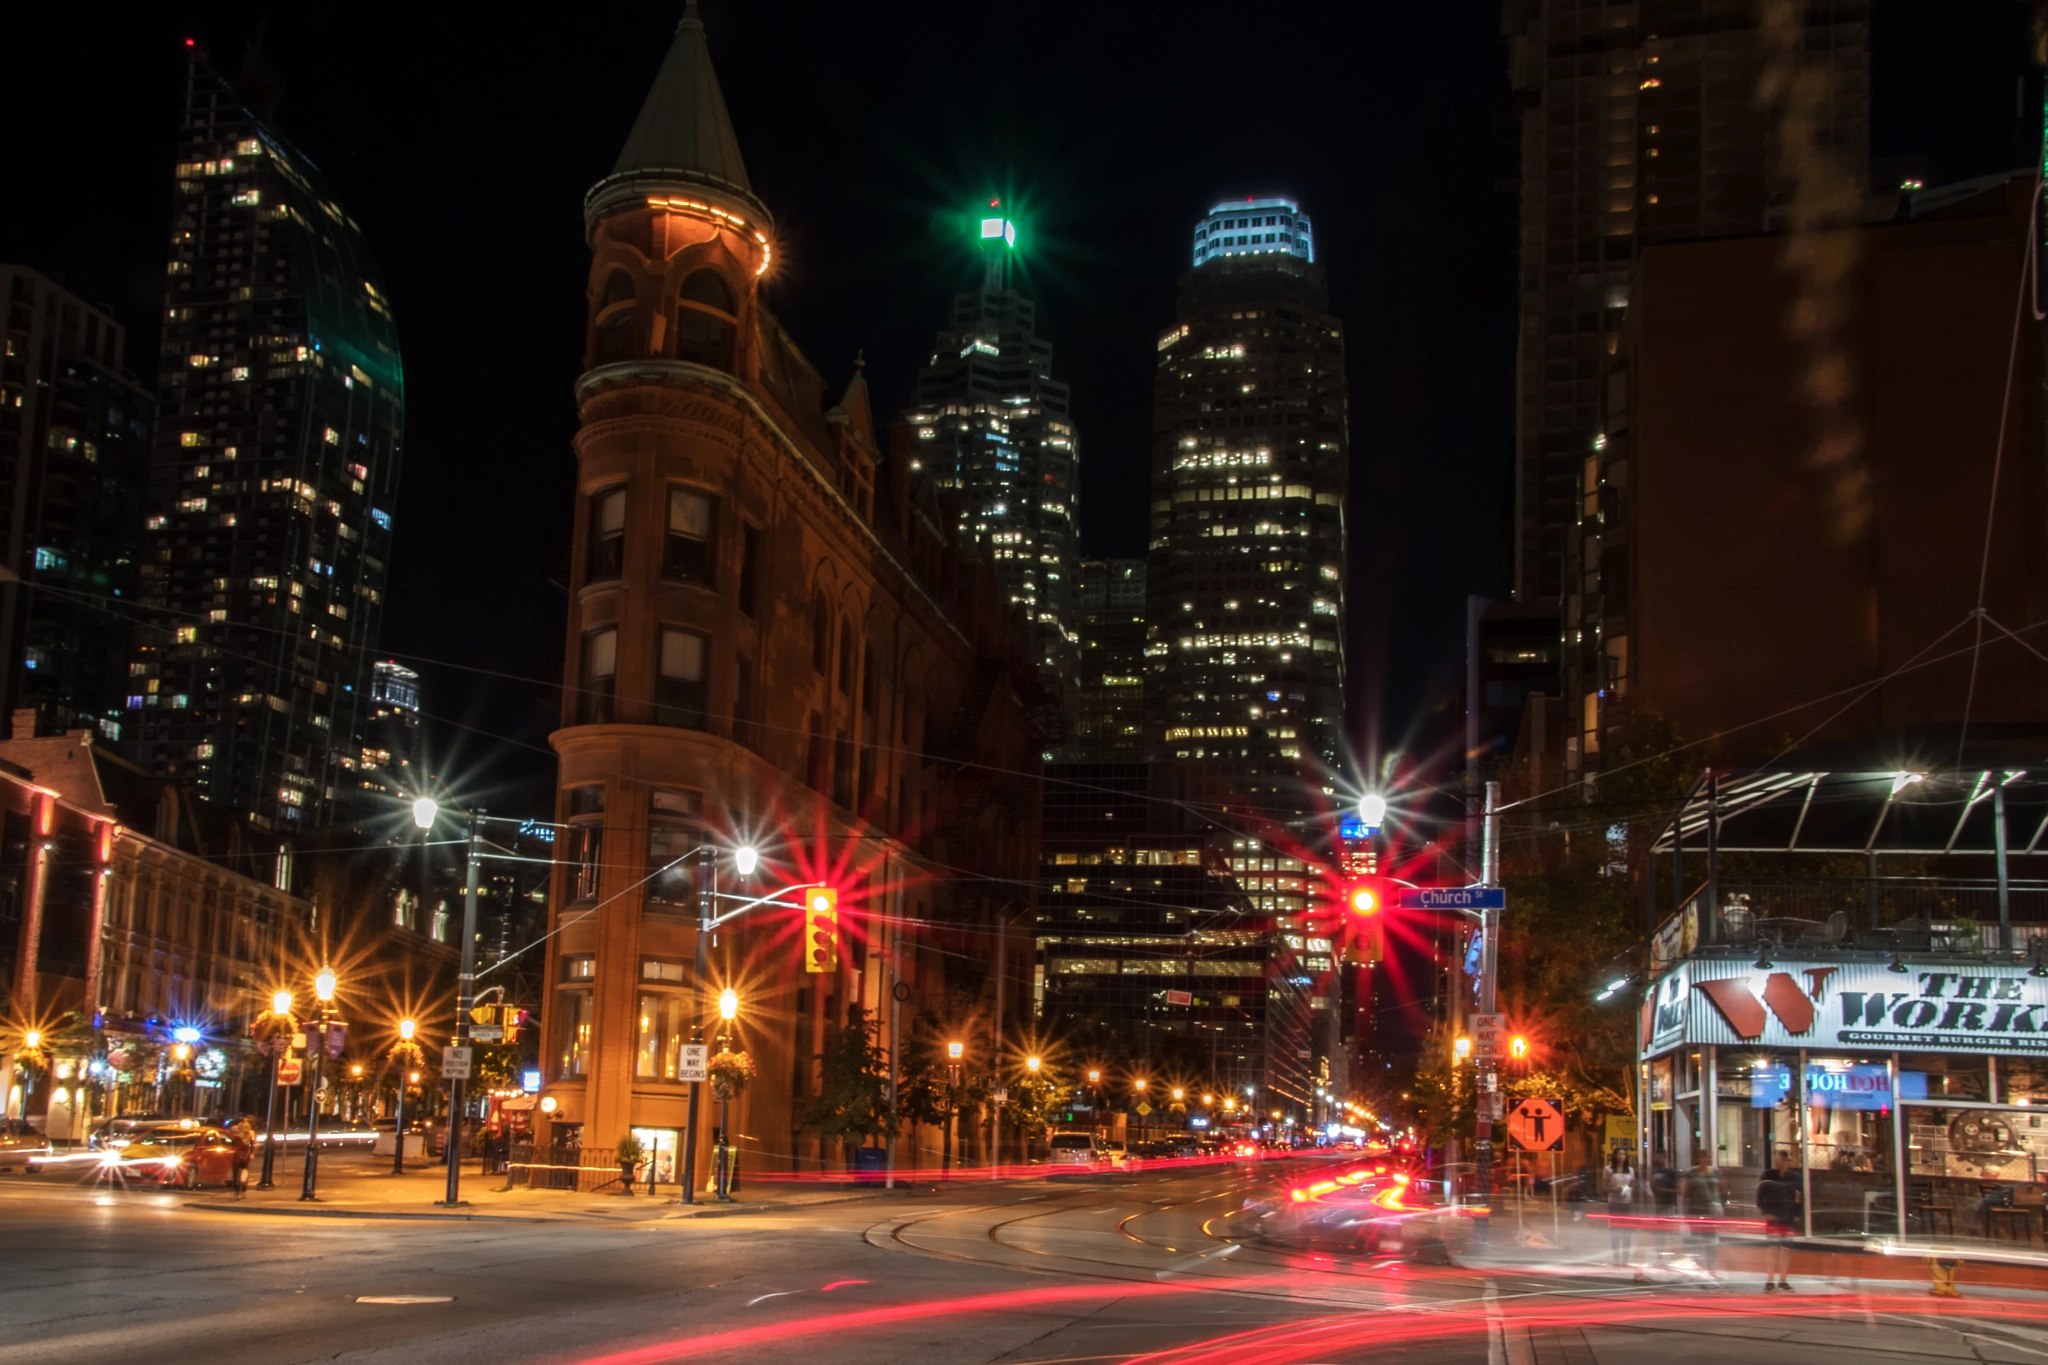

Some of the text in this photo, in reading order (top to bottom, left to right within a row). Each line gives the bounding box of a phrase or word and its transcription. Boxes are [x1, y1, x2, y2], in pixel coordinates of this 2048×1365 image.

[1420, 890, 1483, 904] Church St
[1918, 973, 2027, 1000] THE
[1837, 992, 2048, 1033] WORK
[1477, 1017, 1496, 1027] ONE
[1477, 1031, 1496, 1041] WAY
[1849, 1032, 1934, 1043] GOURMET
[1939, 1036, 2011, 1046] BURGER
[452, 1050, 463, 1059] NO
[687, 1048, 701, 1056] ONE
[687, 1059, 700, 1067] WAY
[680, 1070, 705, 1078] BEGINS
